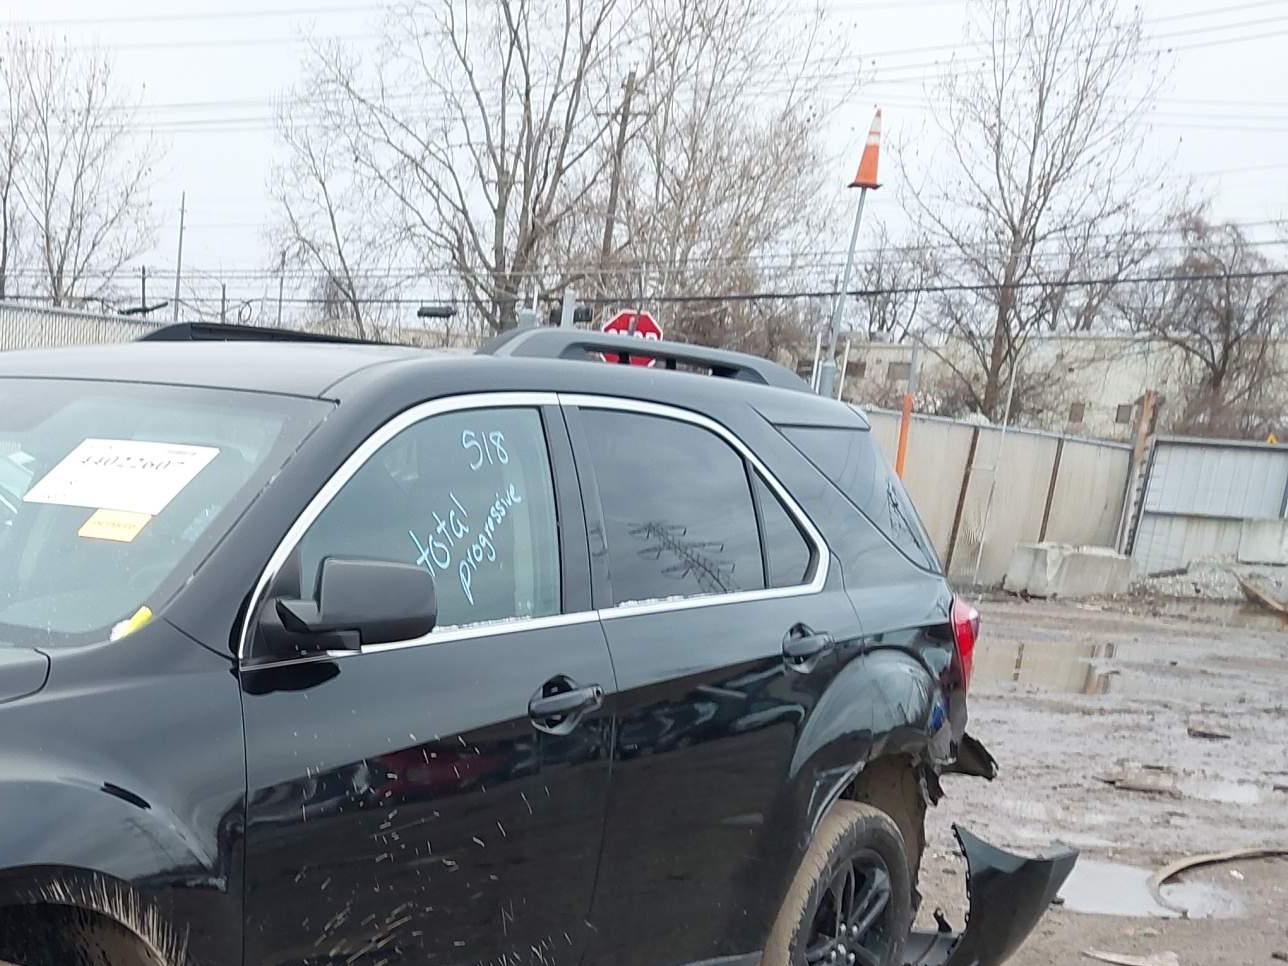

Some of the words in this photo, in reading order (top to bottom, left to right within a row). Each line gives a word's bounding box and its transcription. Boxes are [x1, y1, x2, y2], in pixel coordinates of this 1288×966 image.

[461, 428, 509, 471] 518
[408, 491, 470, 577] total
[458, 483, 523, 606] progressive
